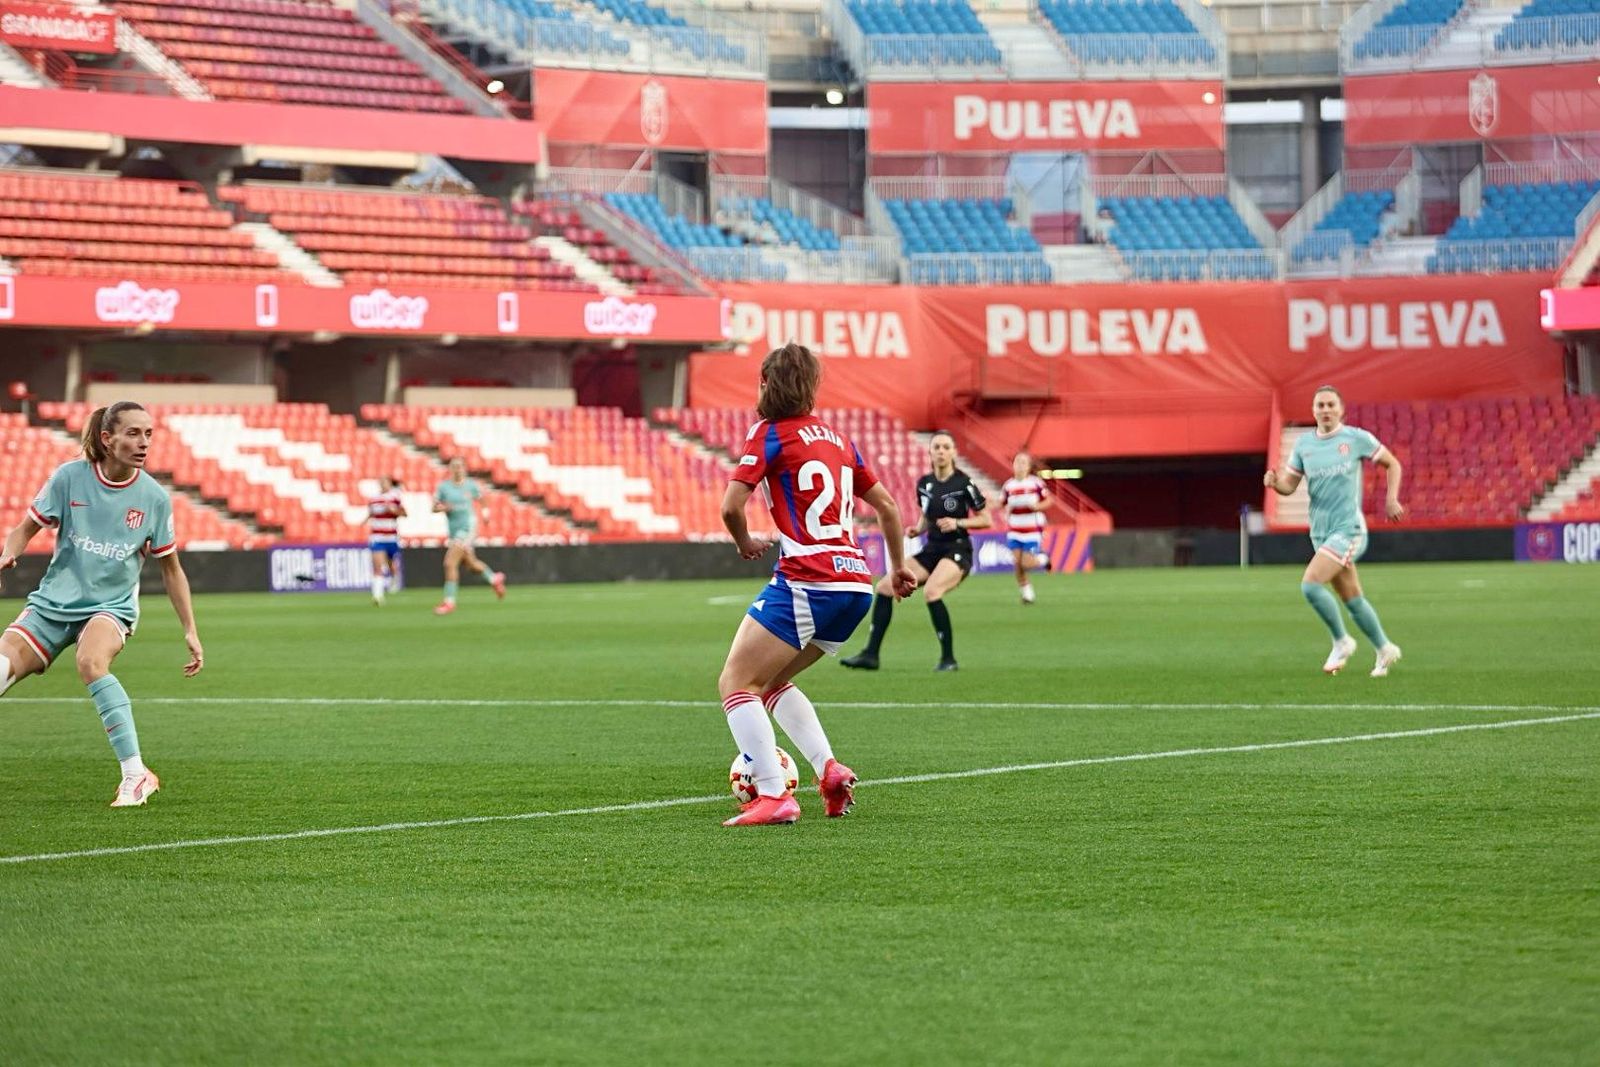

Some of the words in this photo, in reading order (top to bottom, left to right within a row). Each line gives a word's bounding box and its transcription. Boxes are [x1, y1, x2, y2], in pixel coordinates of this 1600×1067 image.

[953, 94, 1141, 140] PULEVA
[733, 301, 910, 358] PULEVA
[985, 303, 1208, 357] PULEVA
[1288, 298, 1506, 351] PULEVA
[797, 424, 845, 451] ALEXIA
[798, 460, 854, 542] 24
